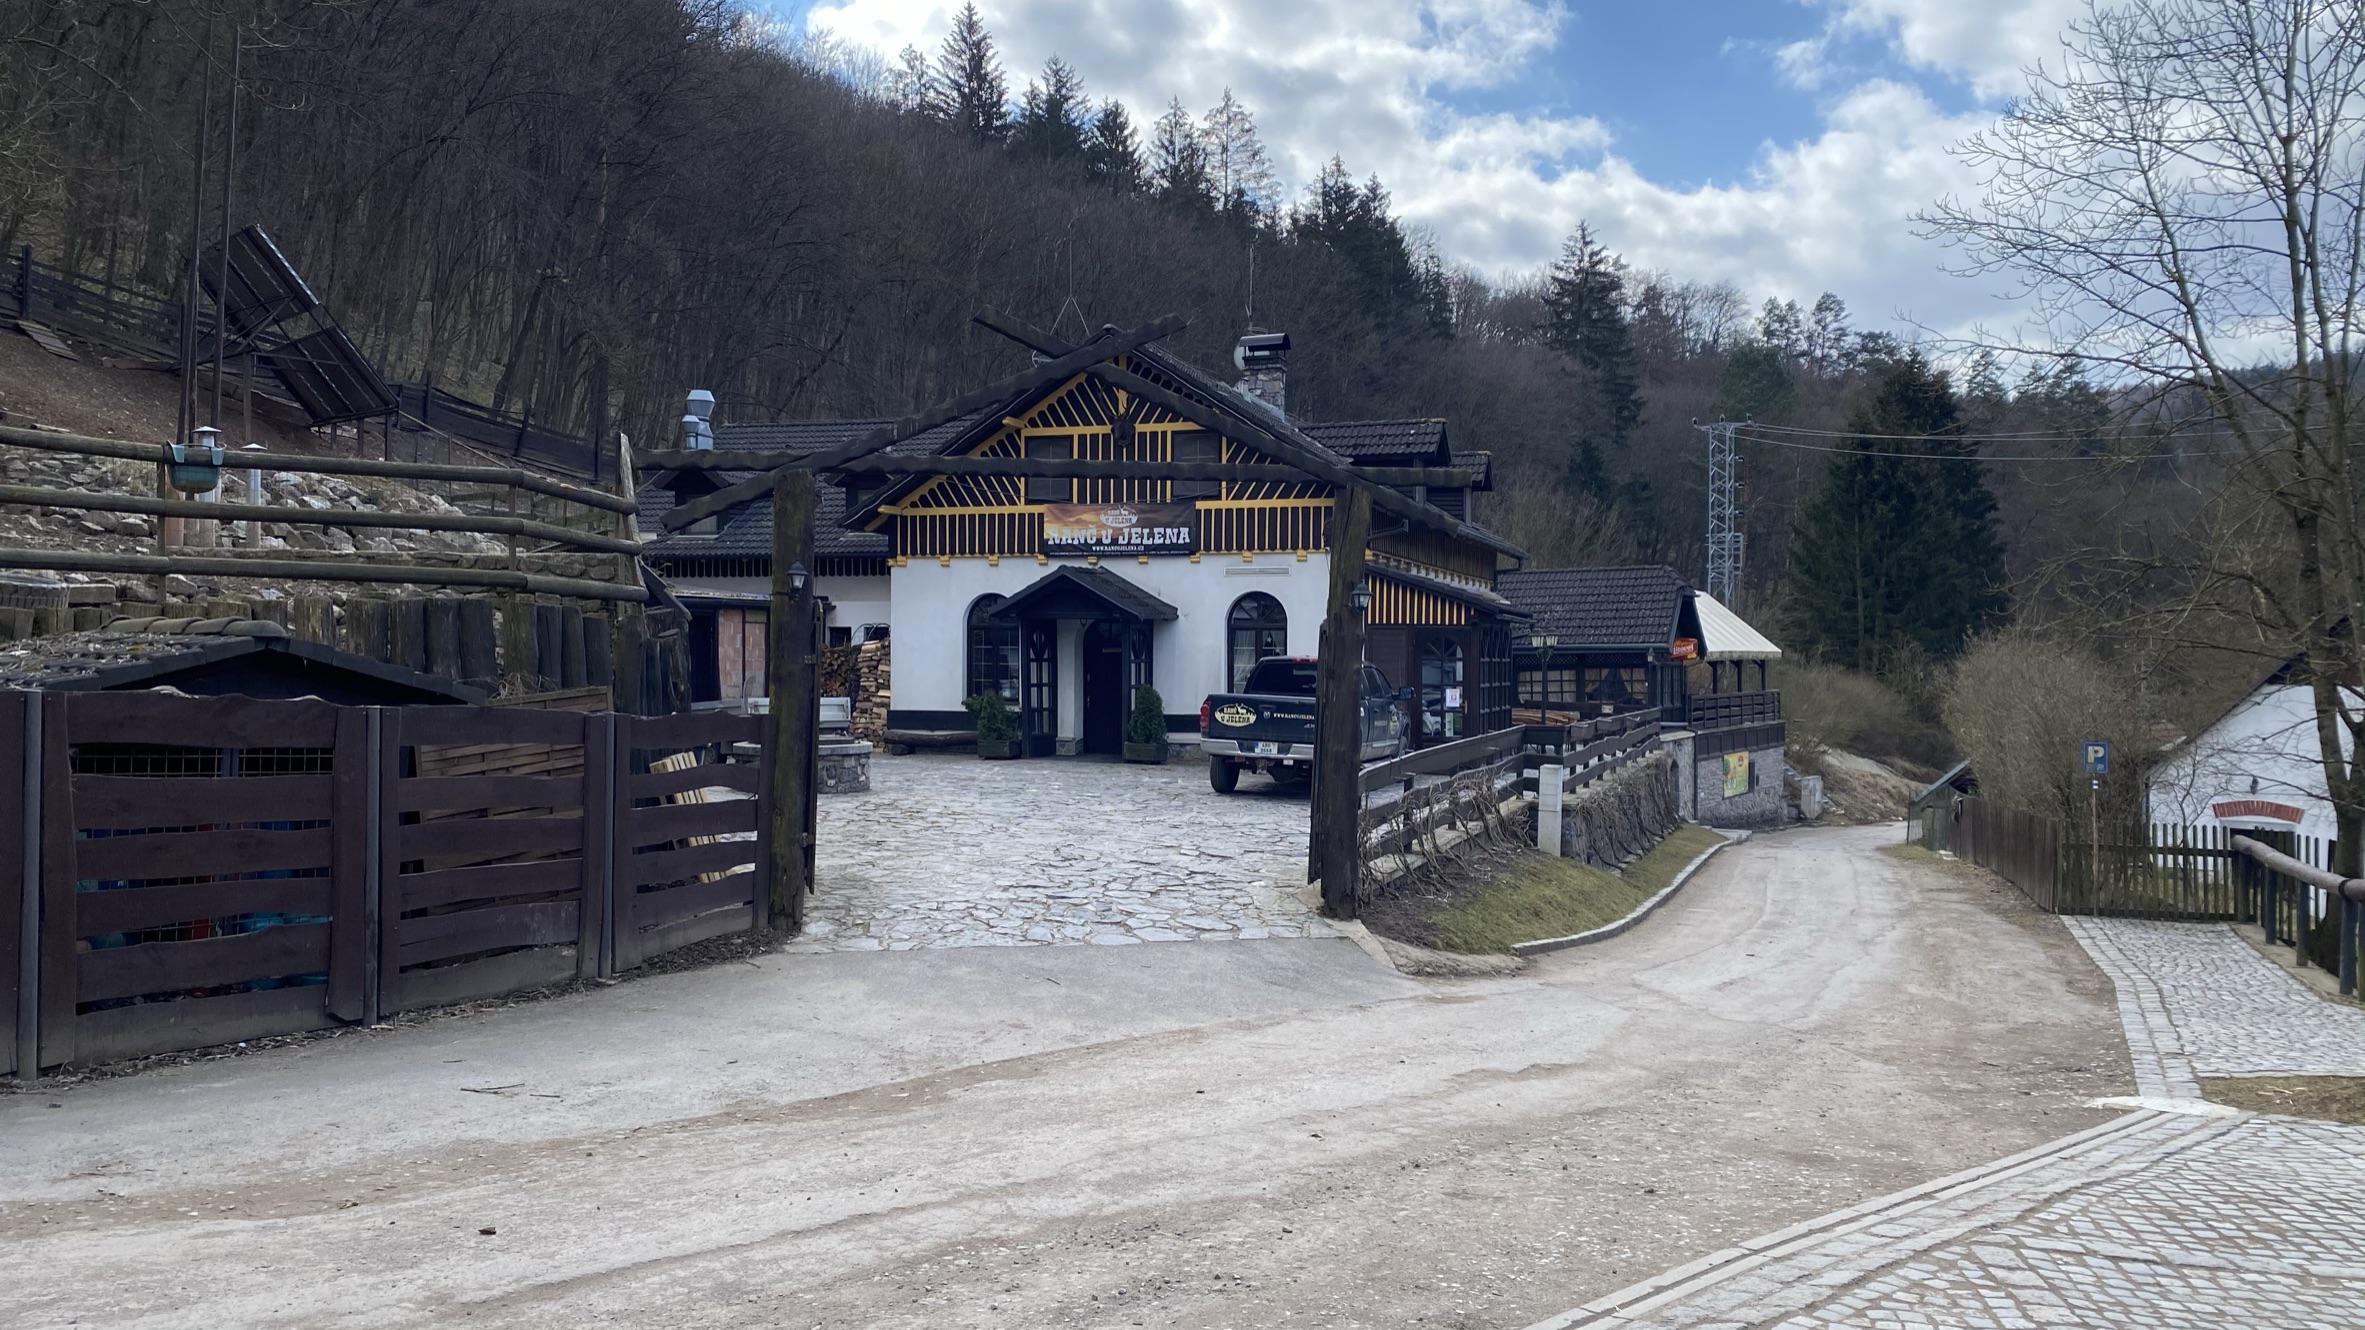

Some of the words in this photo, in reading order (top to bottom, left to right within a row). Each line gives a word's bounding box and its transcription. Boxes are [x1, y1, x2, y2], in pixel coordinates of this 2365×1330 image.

[1048, 525, 1097, 545] RANČ
[1101, 528, 1113, 545] U
[1118, 527, 1191, 545] JELENA
[1226, 715, 1251, 724] JELENA
[2087, 745, 2105, 764] P
